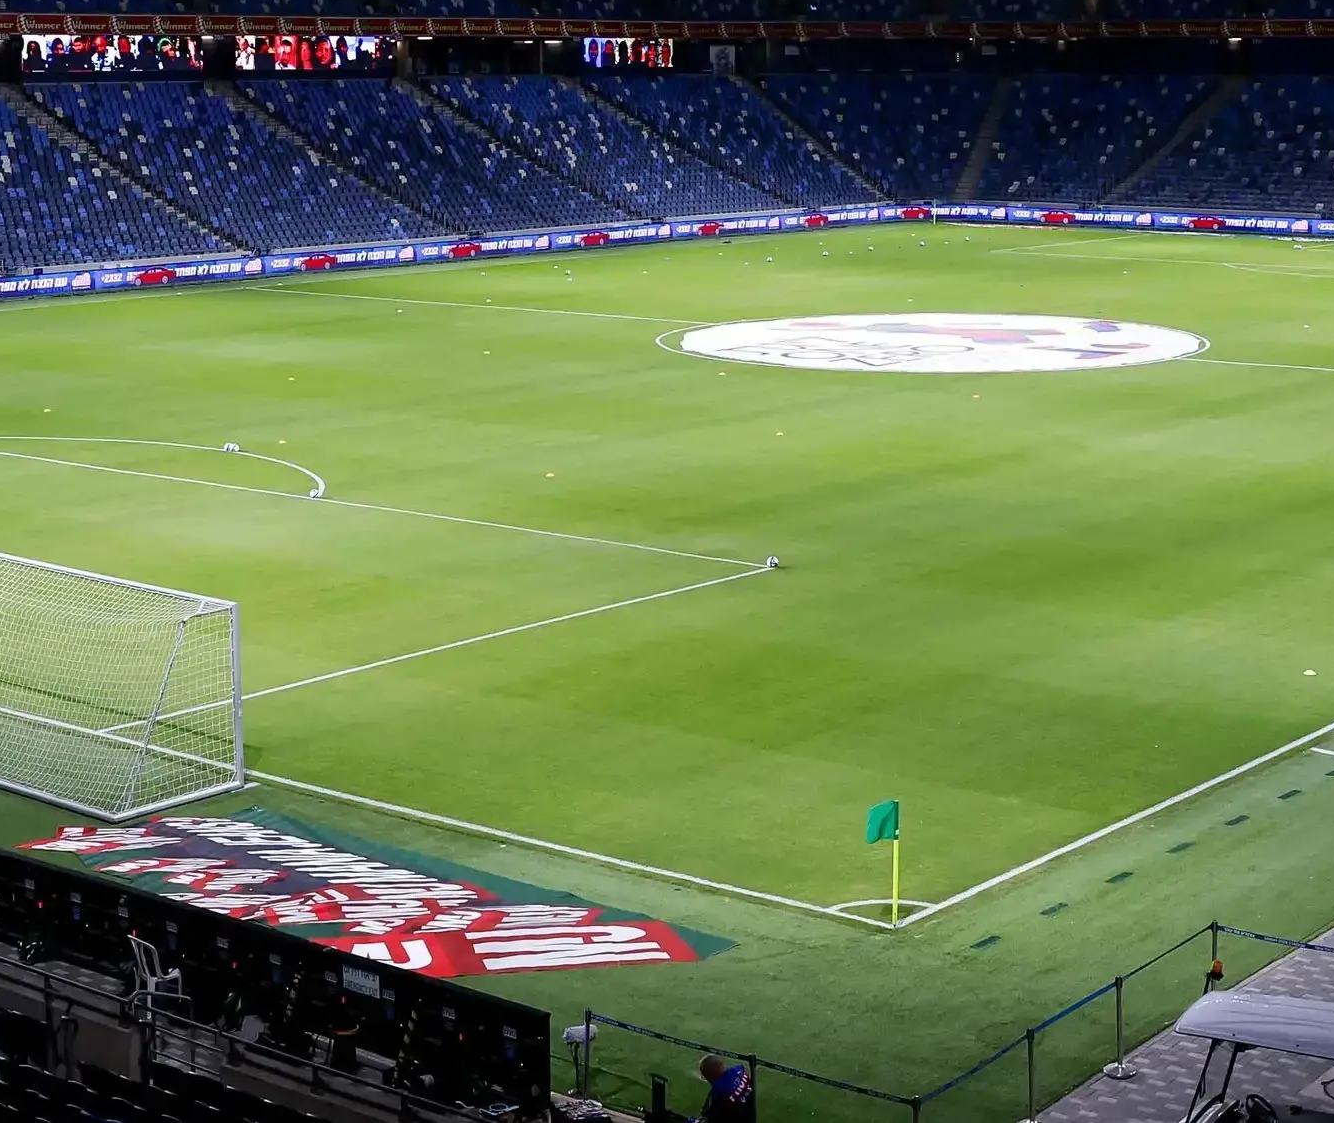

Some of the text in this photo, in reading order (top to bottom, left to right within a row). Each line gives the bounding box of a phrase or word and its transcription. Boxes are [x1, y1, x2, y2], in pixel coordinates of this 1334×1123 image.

[19, 281, 30, 291] לא
[31, 278, 55, 289] הנצח
[54, 277, 68, 288] עם
